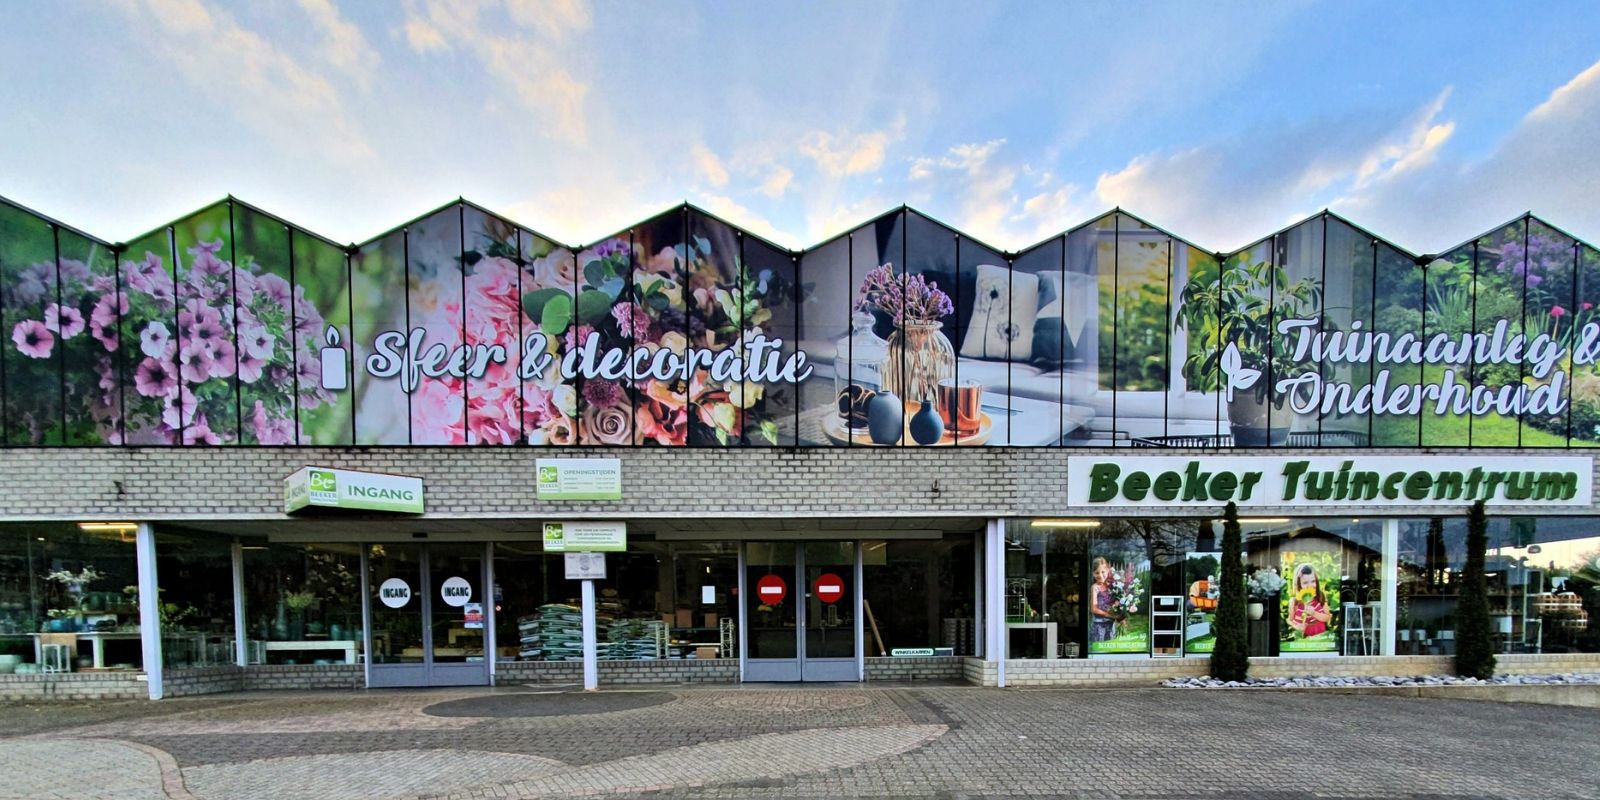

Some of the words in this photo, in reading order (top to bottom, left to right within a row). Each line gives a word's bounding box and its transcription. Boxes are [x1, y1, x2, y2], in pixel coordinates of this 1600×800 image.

[366, 327, 507, 394] Sfeer
[516, 331, 553, 382] &
[561, 329, 816, 384] decoratie
[1277, 316, 1566, 379] Tuinaanleg
[1572, 322, 1600, 366] &
[1275, 369, 1569, 416] Onderhoud
[348, 484, 414, 501] INGANG
[1088, 461, 1263, 502] Beeker
[1280, 460, 1578, 501] Tuincentrum
[383, 588, 408, 598] INGANG
[444, 587, 470, 597] INGANG
